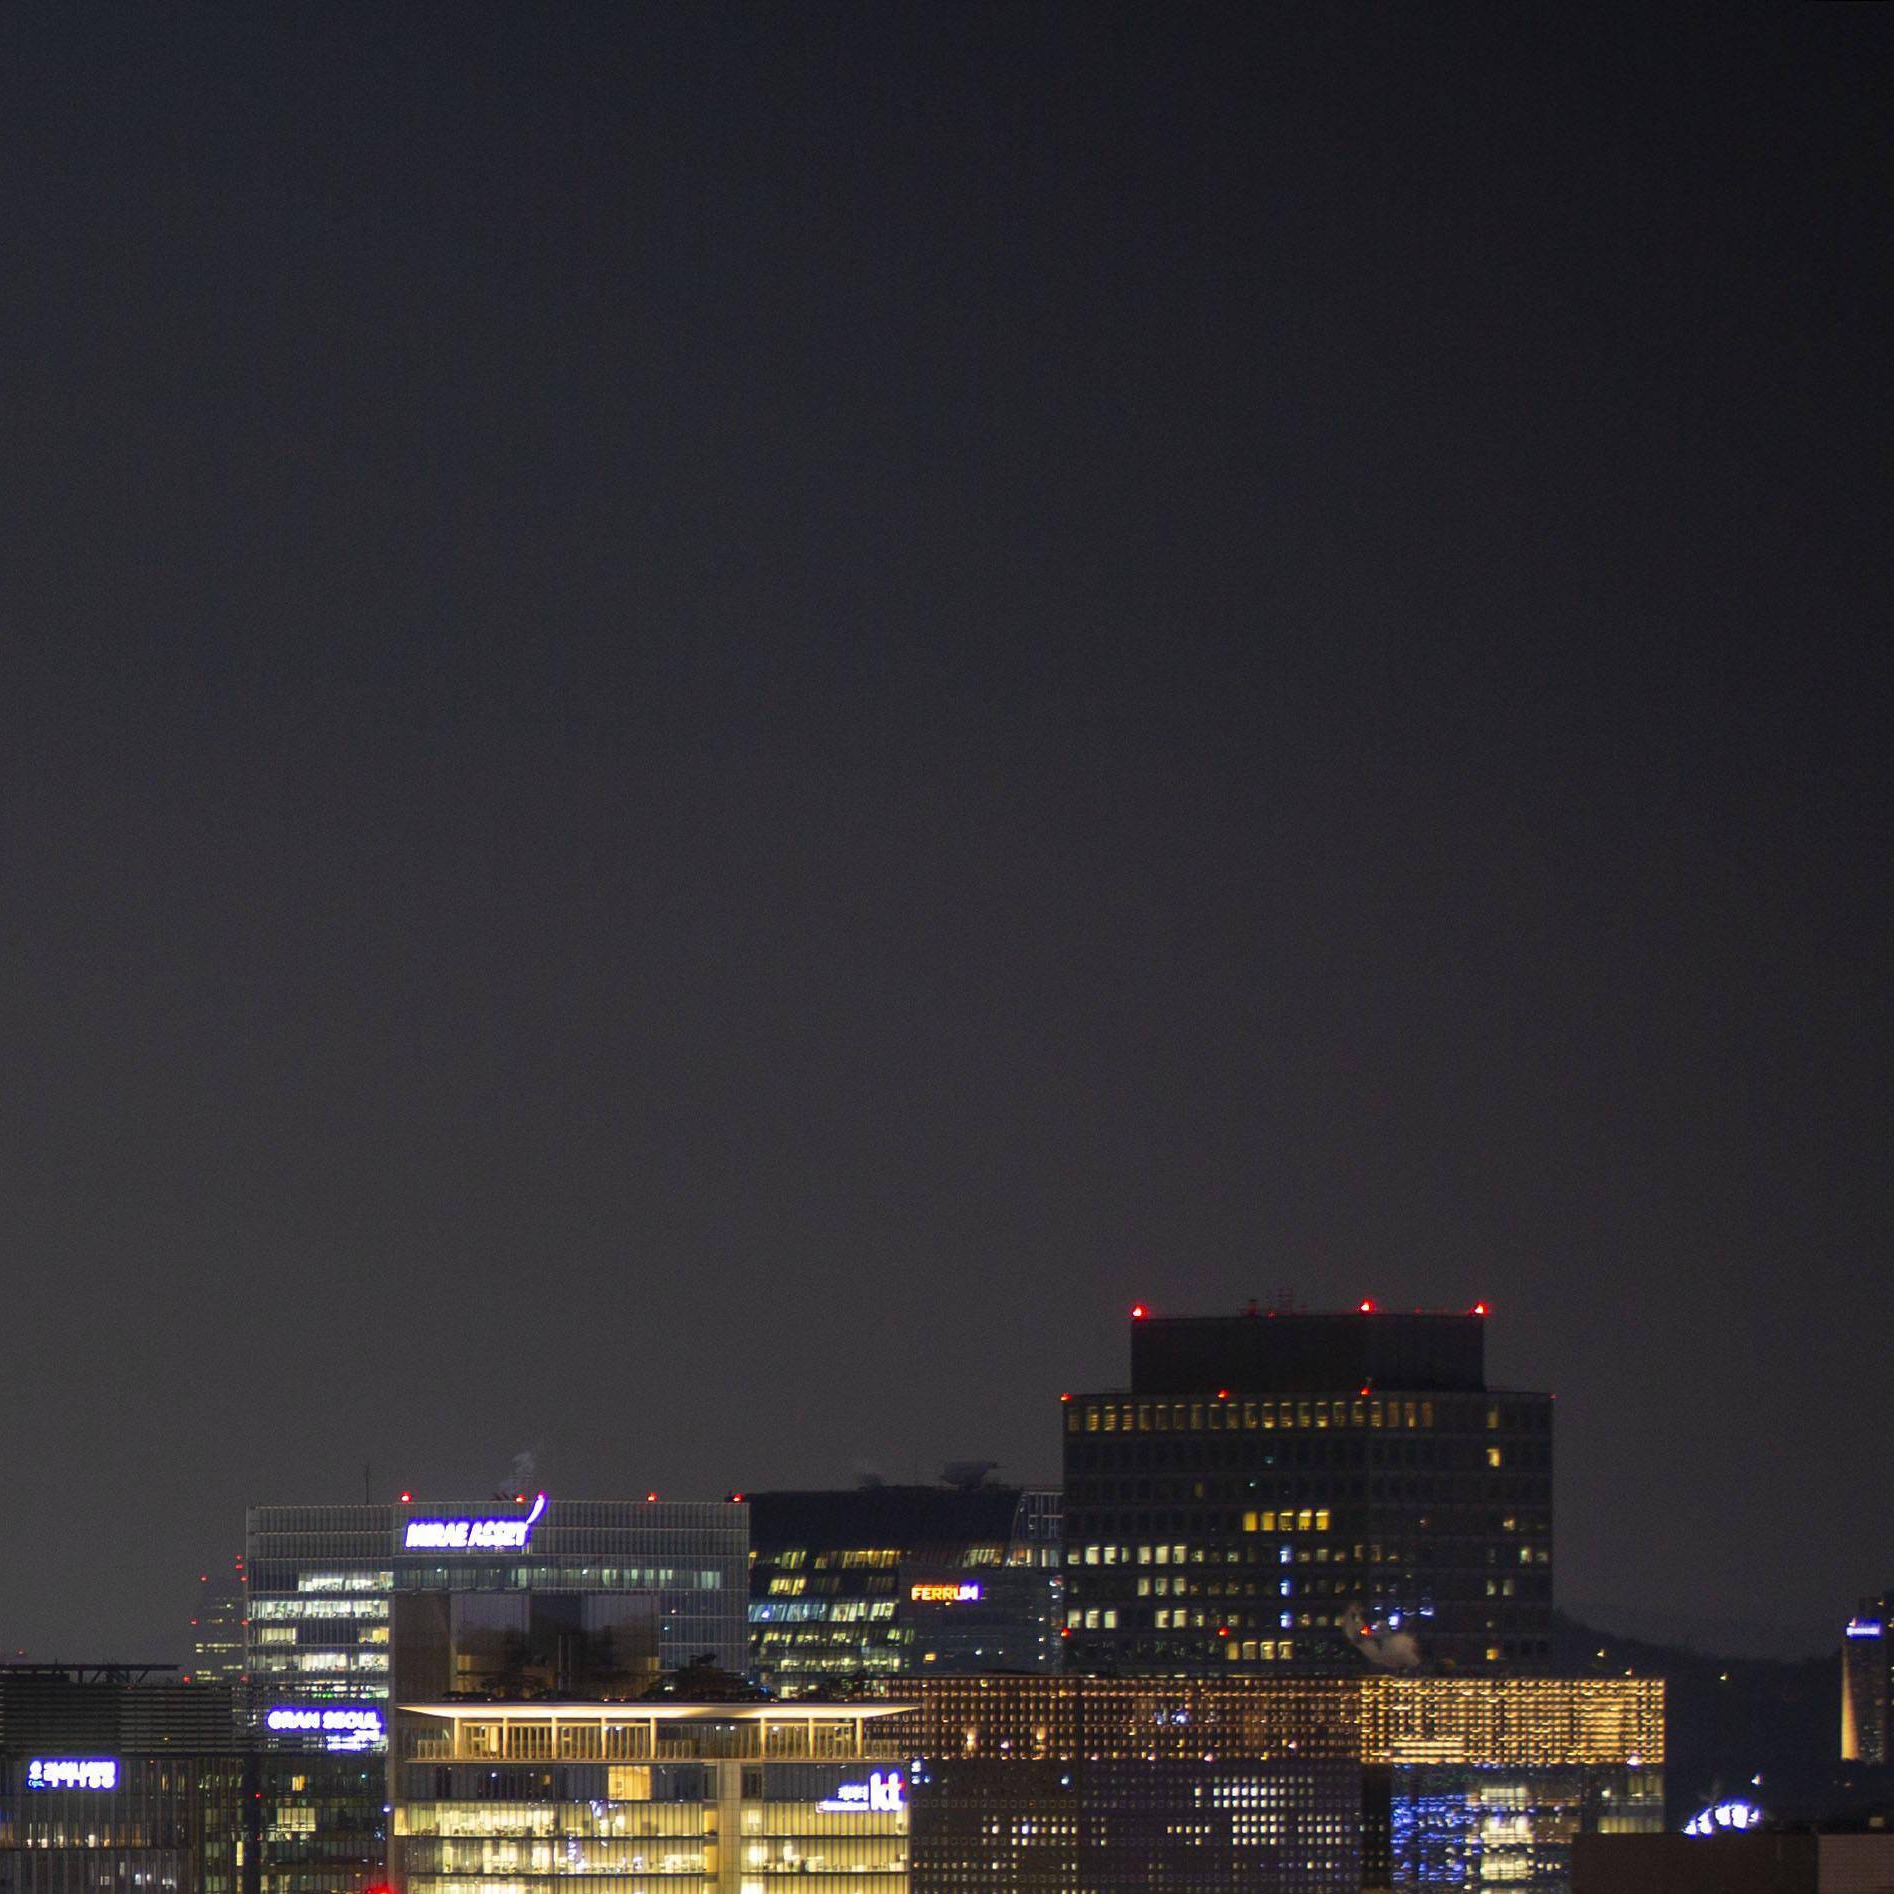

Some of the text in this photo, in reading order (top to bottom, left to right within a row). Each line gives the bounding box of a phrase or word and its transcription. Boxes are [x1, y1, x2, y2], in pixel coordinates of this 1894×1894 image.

[468, 1521, 529, 1548] ASSET
[911, 1586, 979, 1601] FERRUM
[267, 1711, 381, 1729] GRAN SEOUL
[871, 1773, 904, 1811] kt
